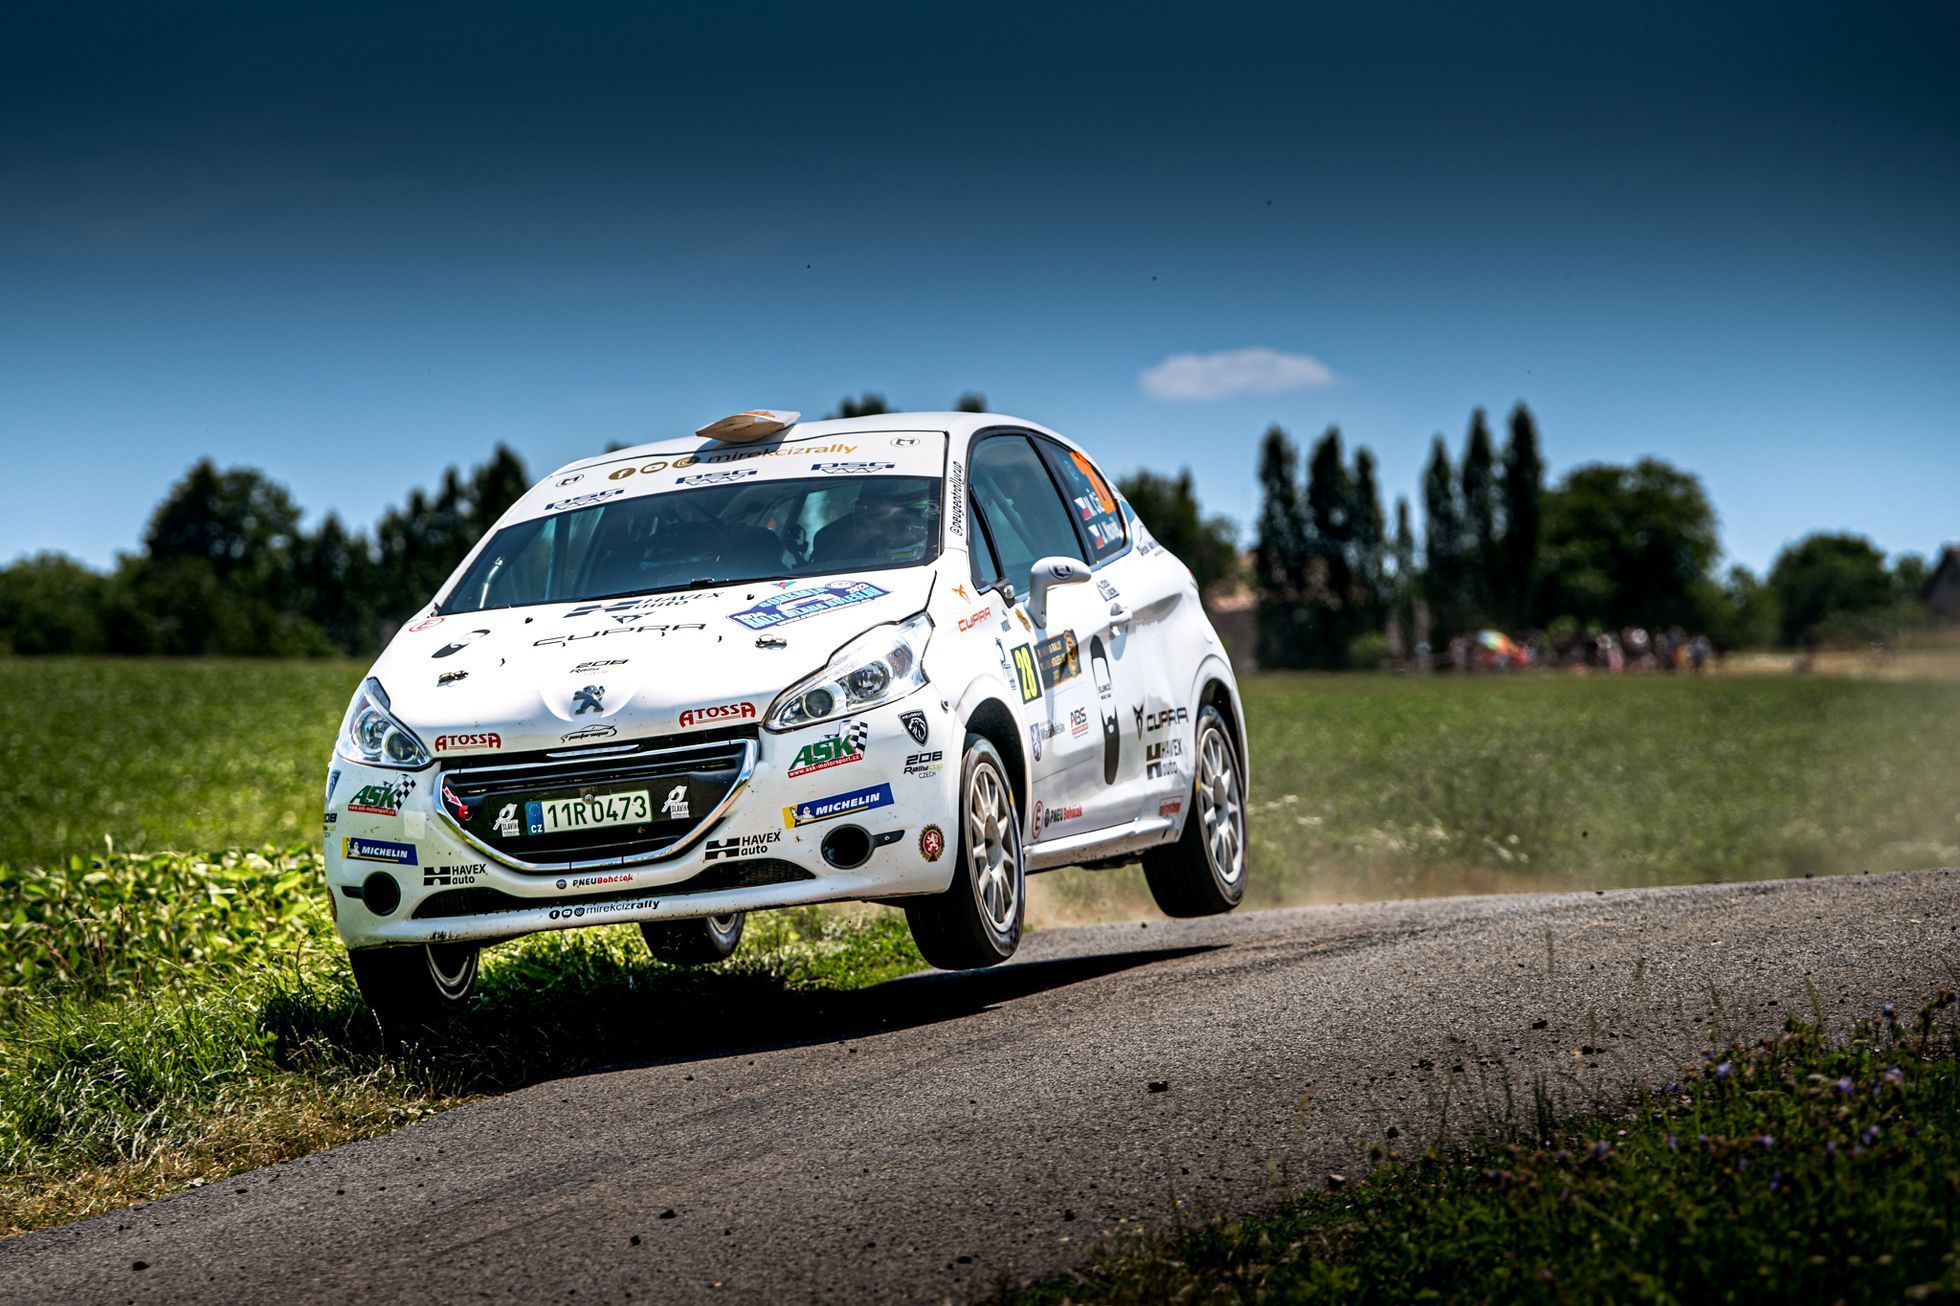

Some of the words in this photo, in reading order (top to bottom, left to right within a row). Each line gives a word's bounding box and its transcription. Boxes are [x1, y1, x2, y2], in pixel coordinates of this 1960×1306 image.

[958, 607, 992, 632] CUPRA
[1013, 646, 1038, 700] 28
[679, 702, 756, 728] ATOSSA
[1070, 707, 1087, 728] ABS
[1146, 706, 1189, 732] CUPRA
[435, 733, 501, 752] ATOSSA
[789, 735, 857, 770] ASK
[905, 751, 943, 766] 208
[350, 785, 400, 808] ASK
[816, 793, 880, 816] MICHELIN
[531, 824, 543, 834] CZ
[741, 831, 781, 846] HAVEX
[361, 846, 408, 858] MICHELIN
[741, 844, 768, 856] auto
[452, 863, 487, 875] HAVEX
[452, 875, 475, 885] auto
